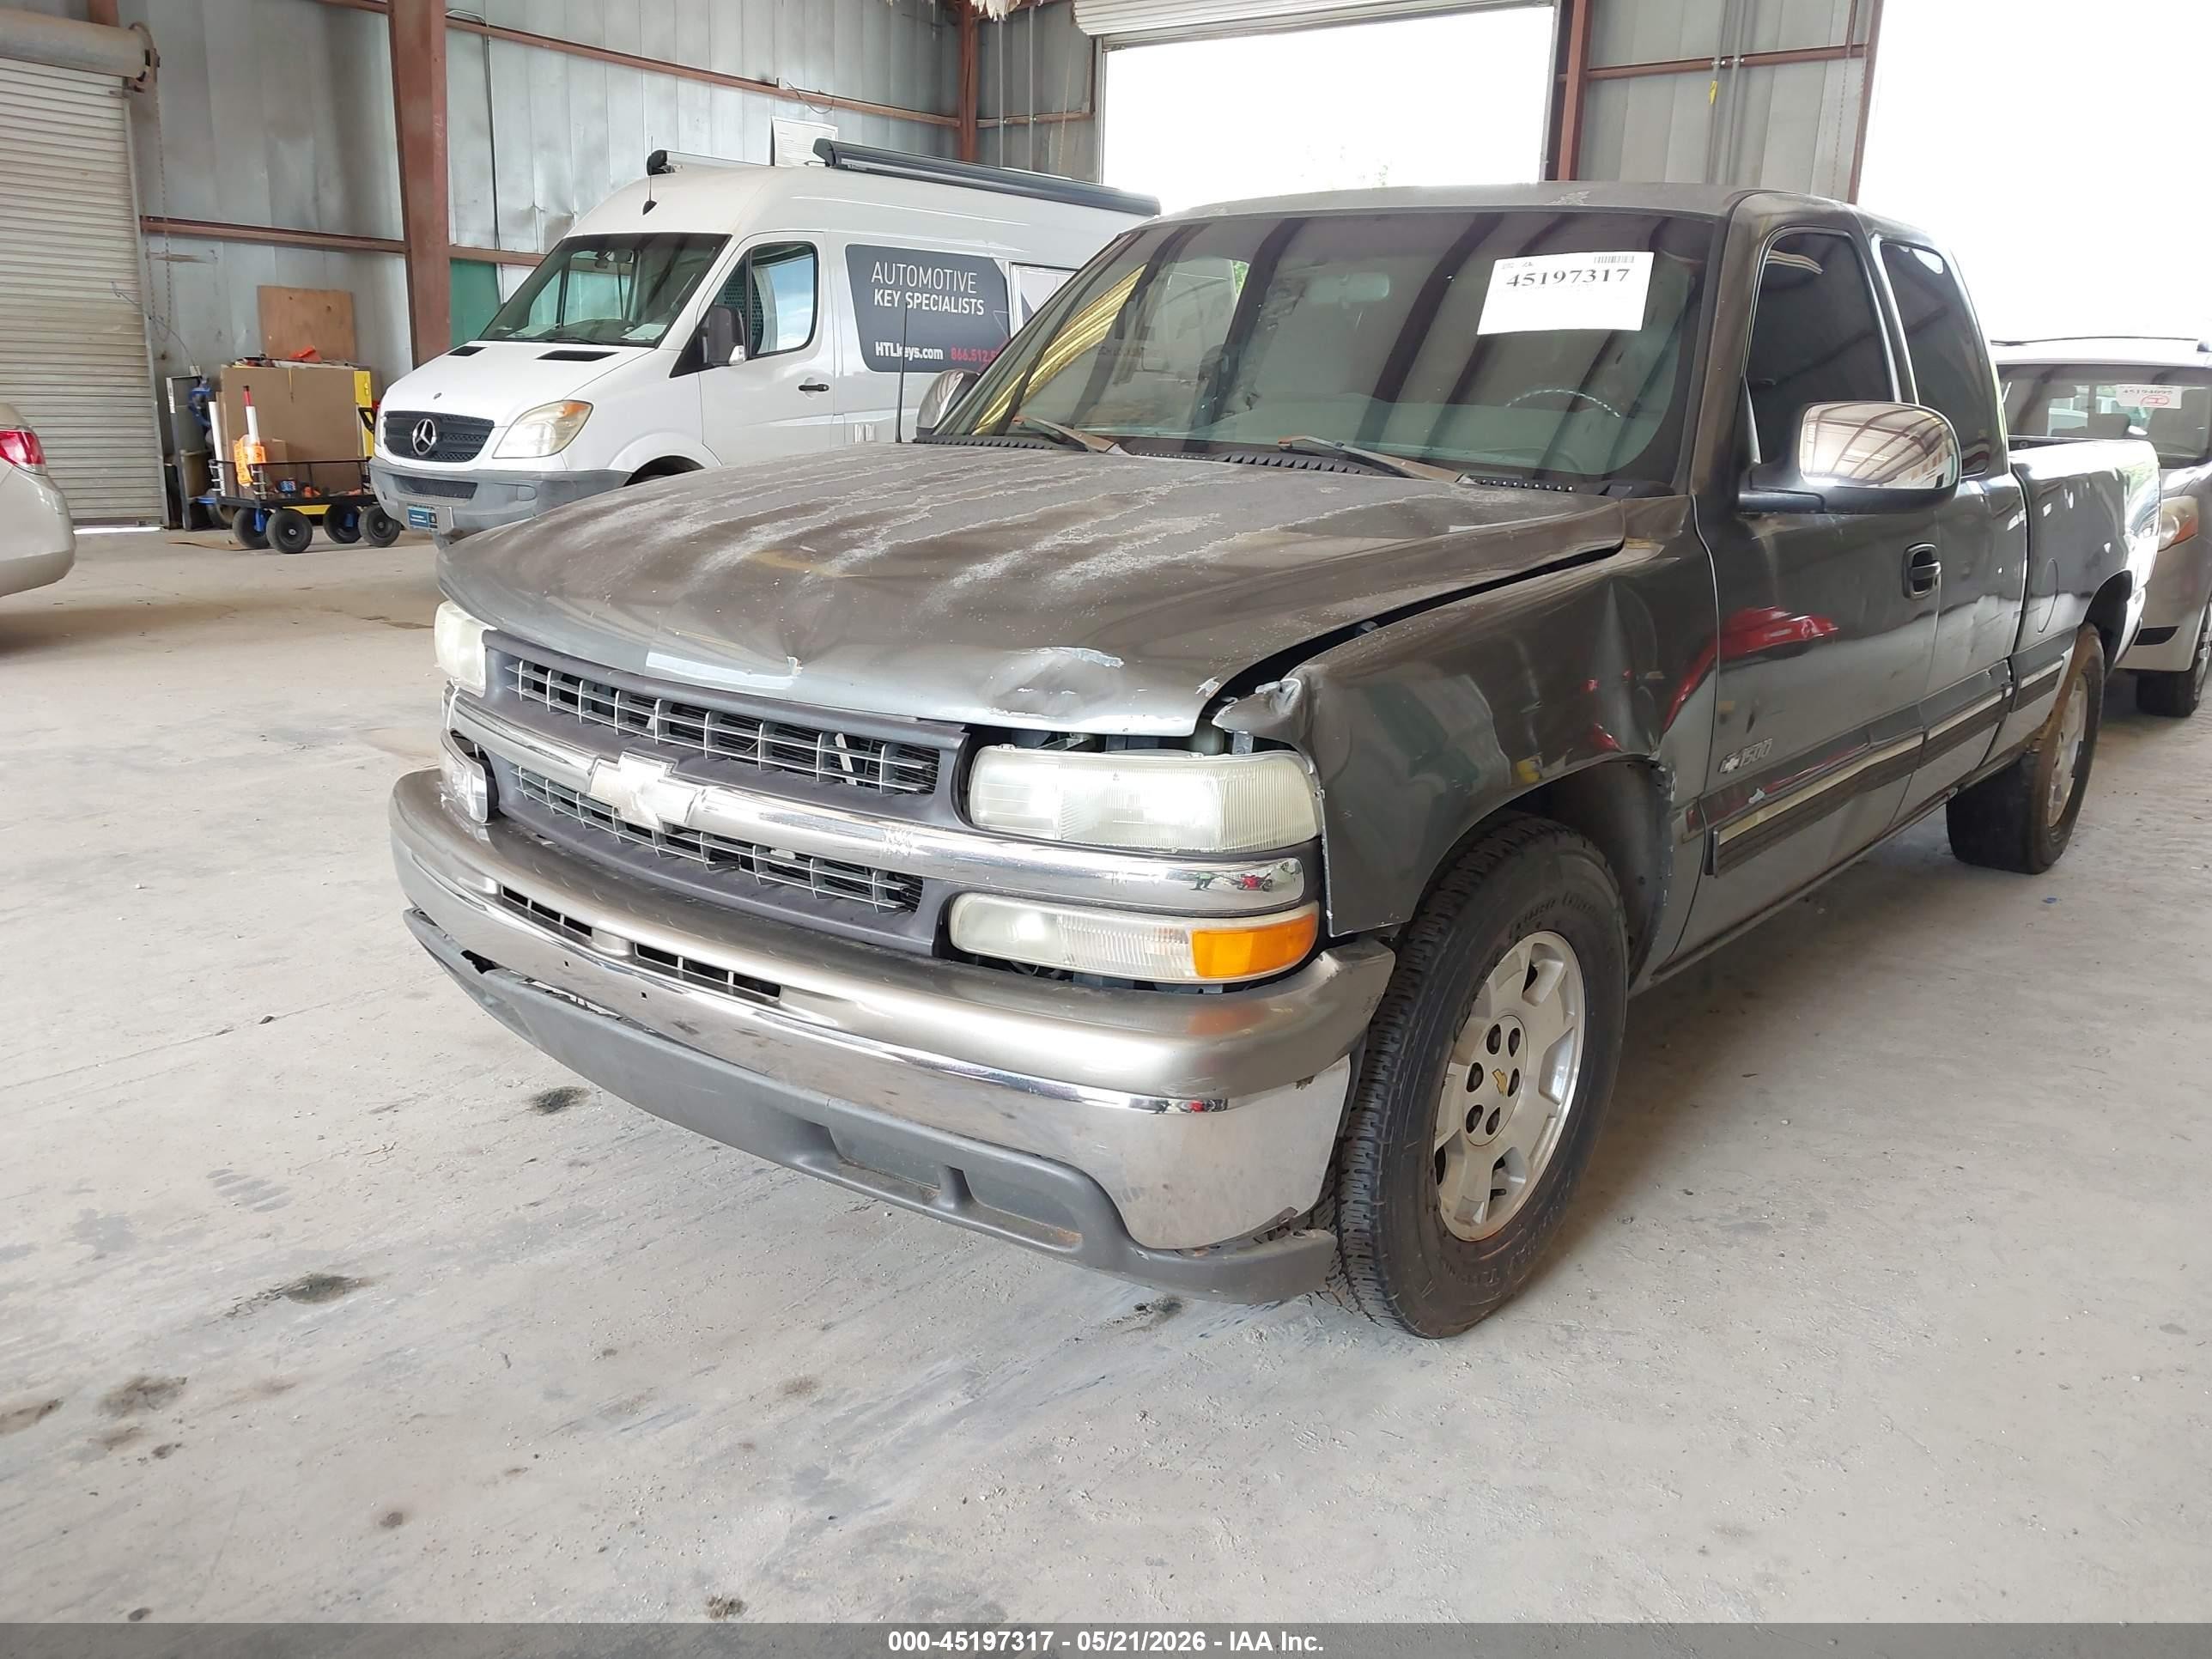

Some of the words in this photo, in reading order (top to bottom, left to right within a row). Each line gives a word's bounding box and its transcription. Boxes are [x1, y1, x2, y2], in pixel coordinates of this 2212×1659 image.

[872, 261, 977, 293] AUTOMOTIVE
[1506, 268, 1631, 287] 45197317
[875, 289, 901, 307] KEY
[905, 292, 984, 315] SPECIALISTS
[875, 341, 943, 361] HTLkeys.com
[951, 347, 999, 362] 866.512.5
[1740, 738, 1772, 767] 1500
